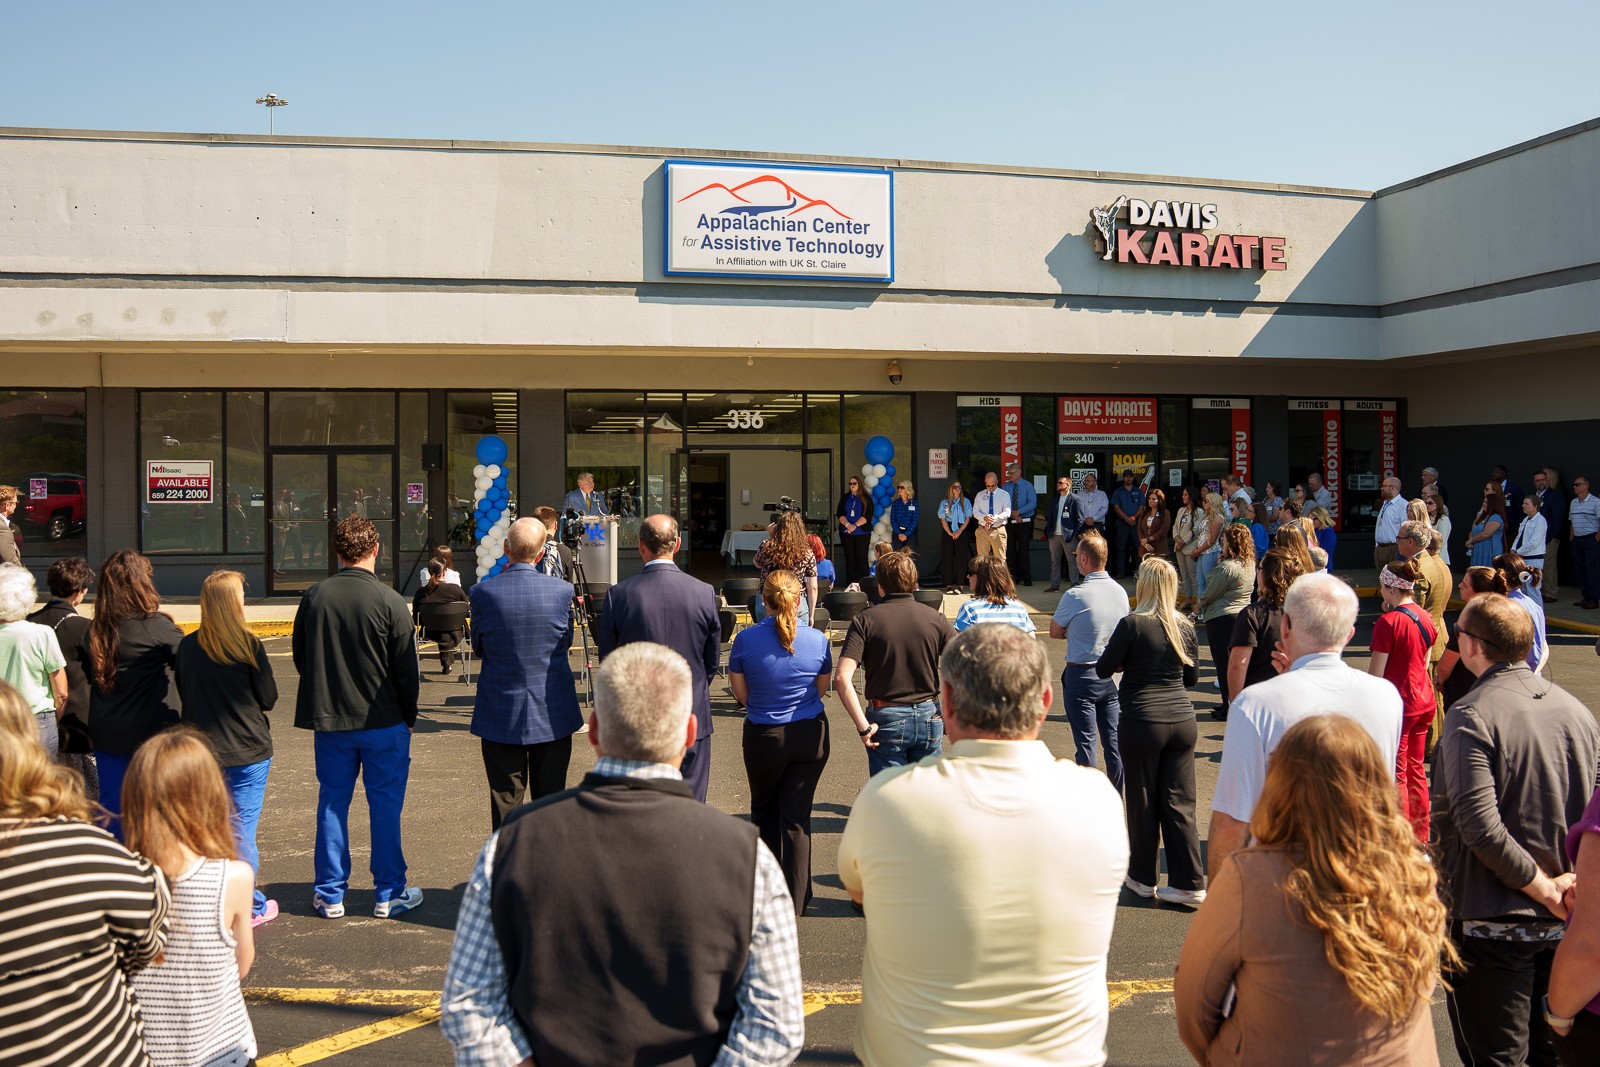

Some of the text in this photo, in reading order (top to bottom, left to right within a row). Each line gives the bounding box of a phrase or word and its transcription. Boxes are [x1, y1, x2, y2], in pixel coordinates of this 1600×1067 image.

[1129, 198, 1218, 230] DAVIS
[697, 213, 871, 235] Appalachian Center
[682, 234, 885, 259] for Assistive Technology
[1116, 228, 1287, 271] KARATE
[716, 256, 847, 269] In Affiliation with UK St. Claire
[979, 397, 1000, 406] KIDS
[1064, 400, 1152, 417] DAVIS KARATE
[1210, 399, 1231, 407] MMA
[1298, 401, 1329, 409] FITNESS
[1356, 402, 1383, 410] ADULTS
[727, 409, 764, 429] 336
[1005, 413, 1018, 456] ARTS
[1383, 415, 1394, 479] DEFENSE
[1074, 453, 1094, 464] 340
[1113, 454, 1146, 466] NOW
[1235, 431, 1248, 487] -JITSU
[1326, 419, 1339, 518] KICKBOXING
[157, 479, 208, 487] AVAILABLE
[166, 489, 183, 499] 224
[185, 489, 208, 499] 2000
